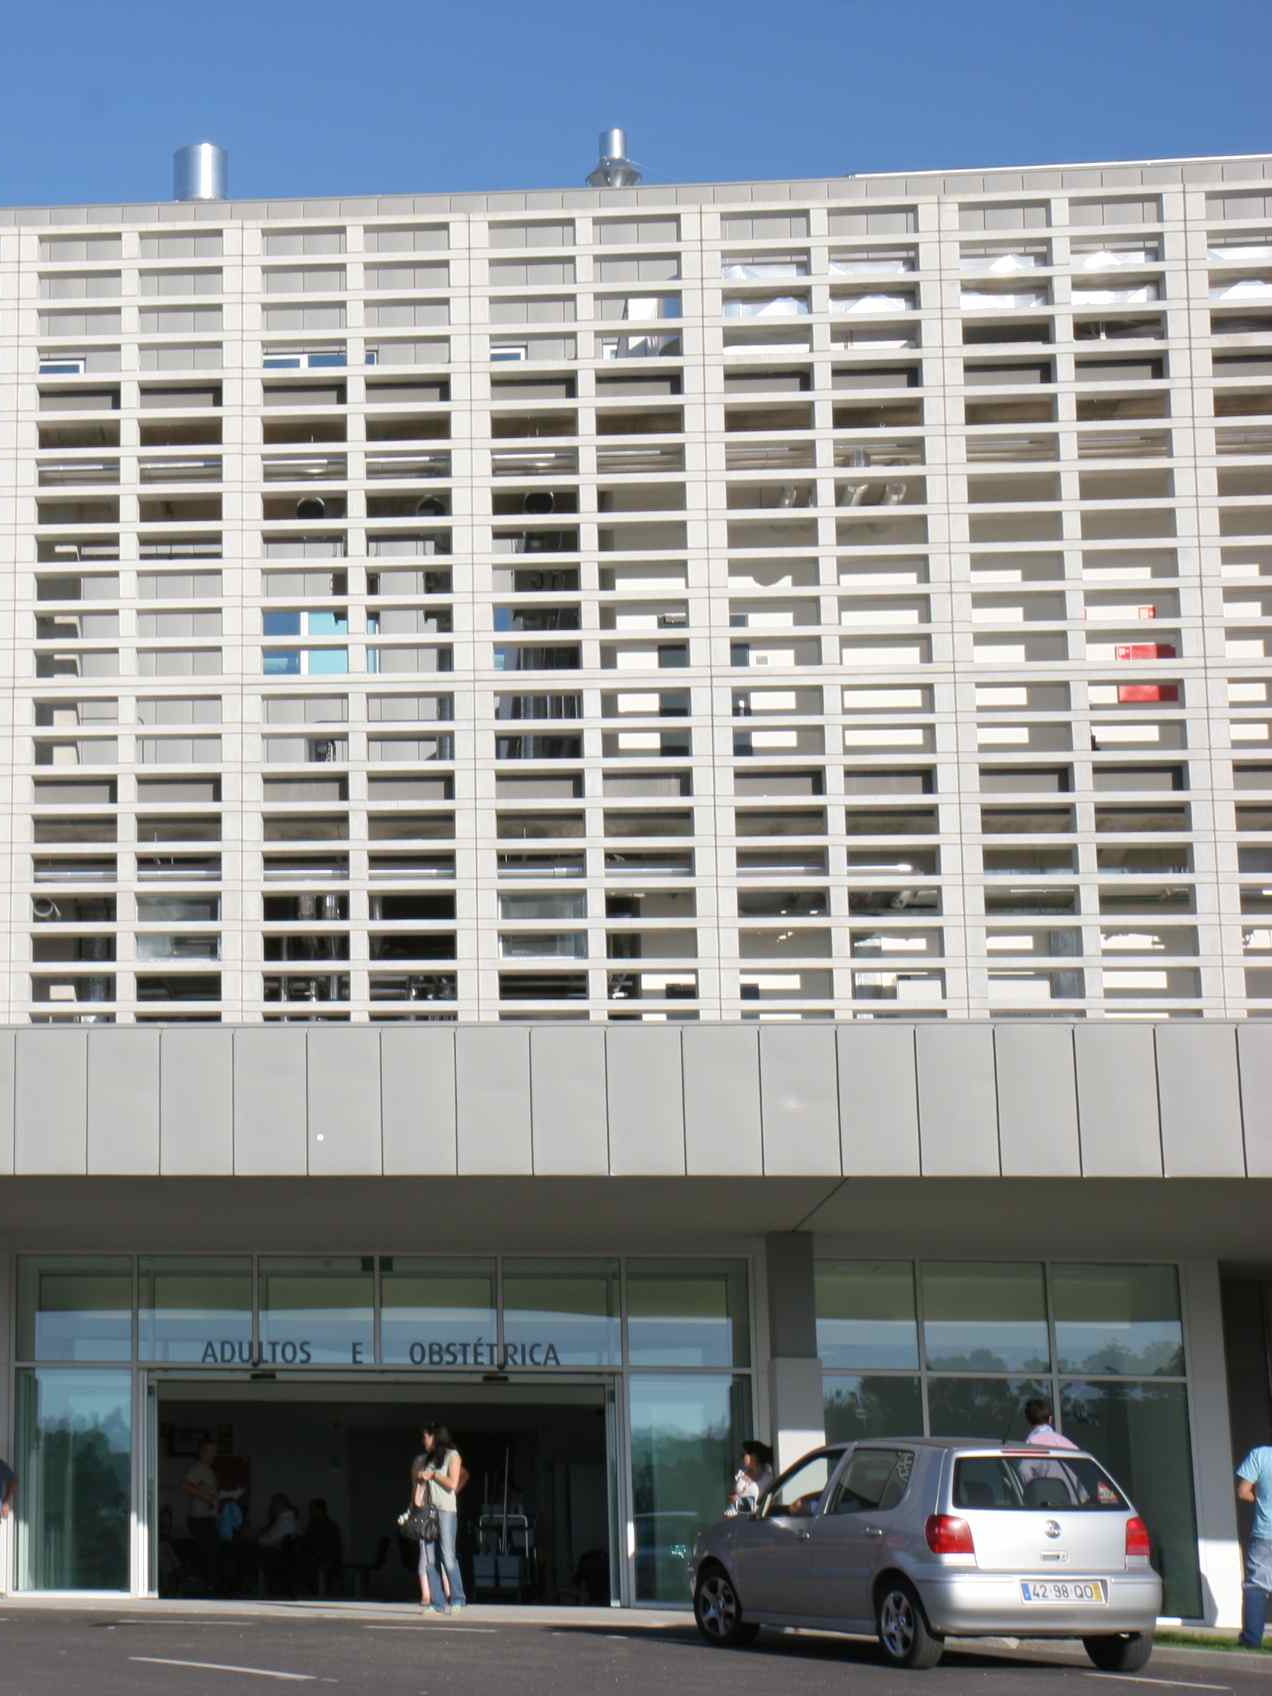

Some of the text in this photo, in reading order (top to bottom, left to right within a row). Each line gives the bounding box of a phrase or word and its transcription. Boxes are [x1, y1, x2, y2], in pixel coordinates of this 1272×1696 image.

[201, 1337, 561, 1366] ADULTOS E OBSTÉTRICA
